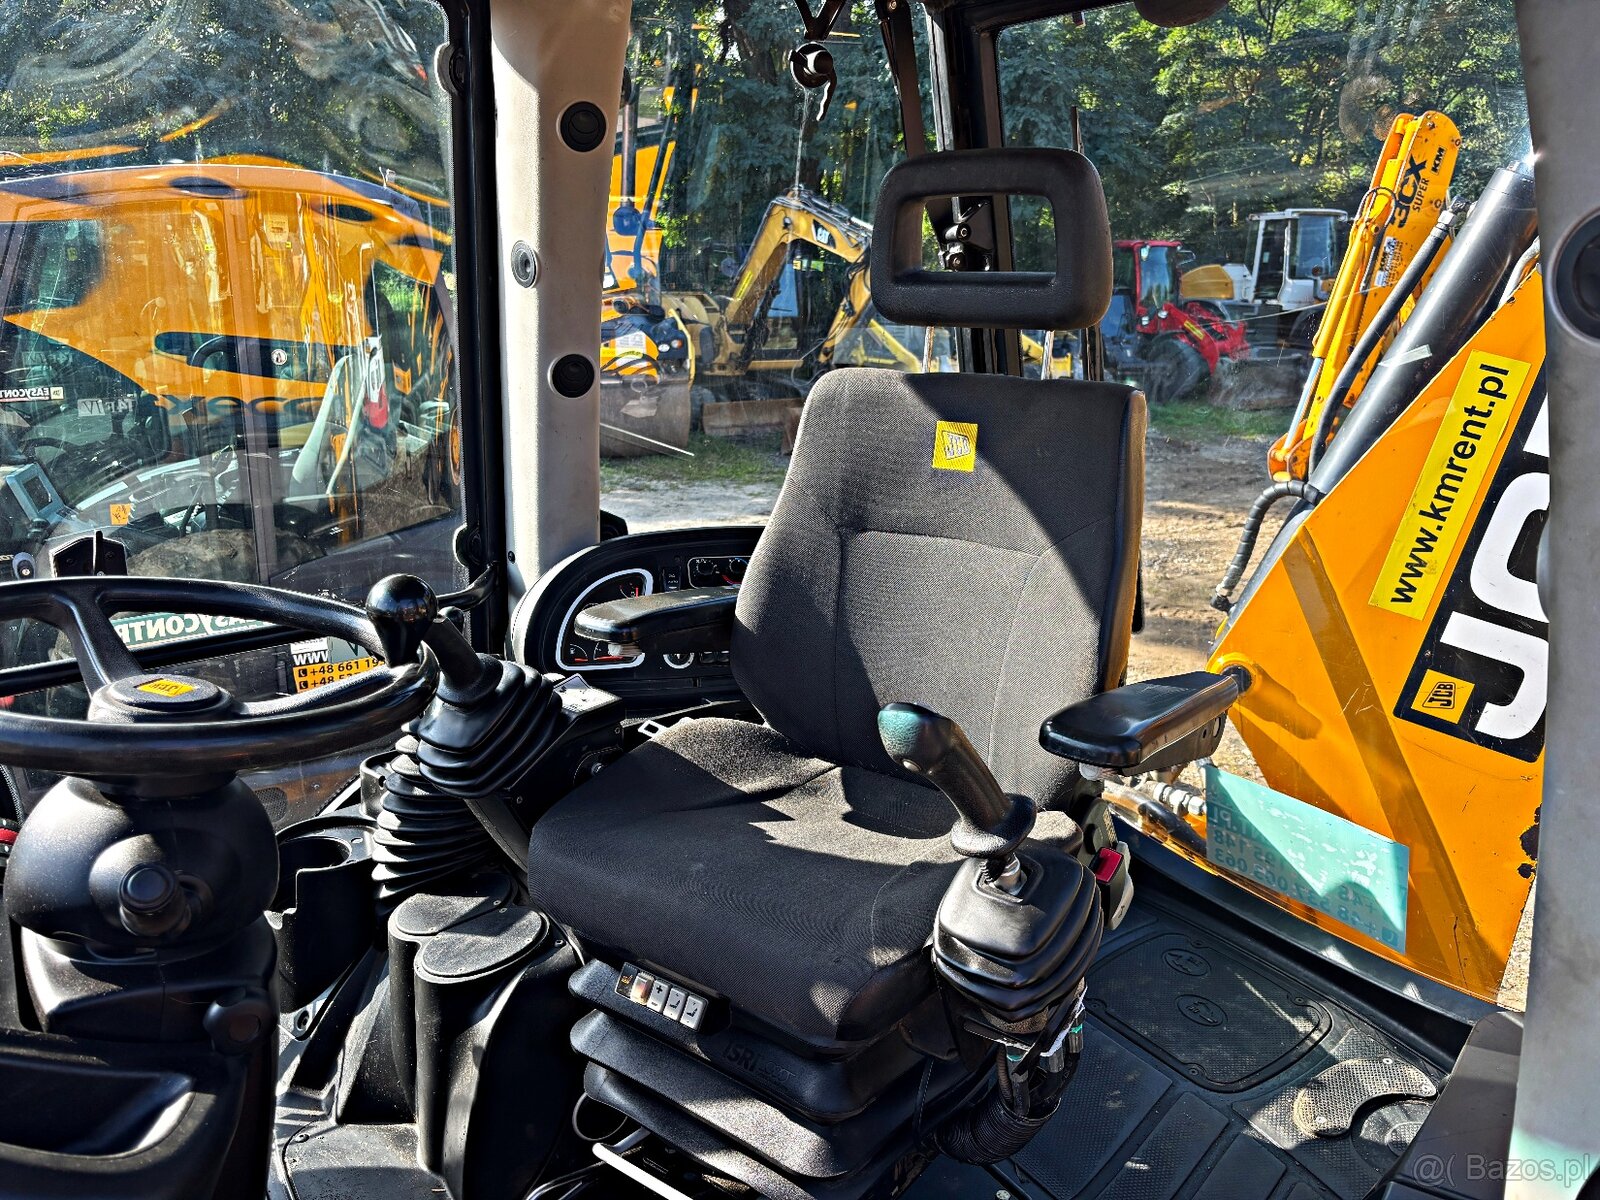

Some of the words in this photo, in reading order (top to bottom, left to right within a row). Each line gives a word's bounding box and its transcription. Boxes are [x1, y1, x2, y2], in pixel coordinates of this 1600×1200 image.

[1431, 147, 1446, 173] KM
[1390, 154, 1427, 228] 3CX
[1413, 178, 1430, 212] SUPER
[1390, 363, 1510, 605] www.kmrent.pl
[310, 664, 334, 676] +48
[337, 661, 360, 672] 661
[1428, 684, 1453, 706] JCB
